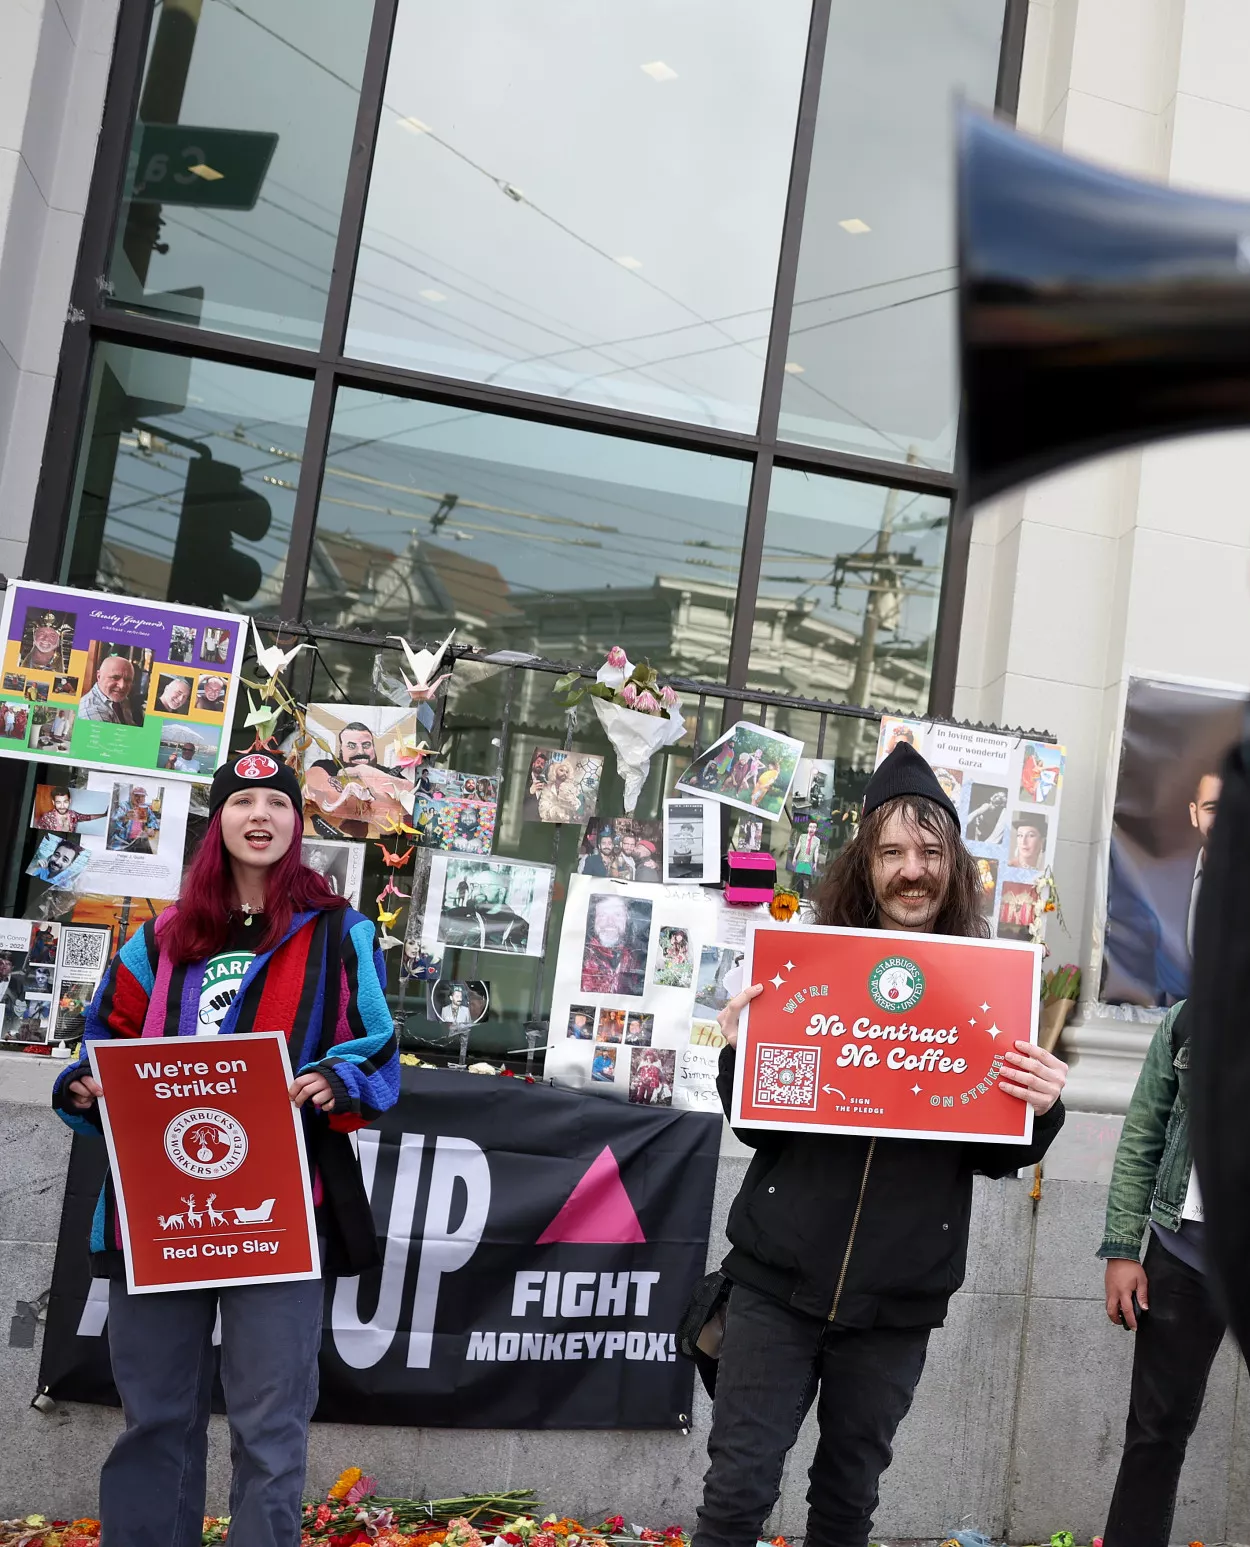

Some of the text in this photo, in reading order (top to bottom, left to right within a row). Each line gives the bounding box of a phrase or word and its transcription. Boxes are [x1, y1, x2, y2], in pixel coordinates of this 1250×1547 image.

[937, 729, 1008, 747] In loving memory
[958, 757, 982, 768] Garza
[965, 747, 1007, 759] wonderful
[664, 887, 712, 902] JAMES
[7, 934, 27, 943] Conroy
[875, 958, 920, 978] STARBUCKS
[782, 984, 829, 1014] WE'RE
[871, 980, 896, 1011] WORKERS
[901, 983, 923, 1010] UNITED
[805, 1013, 959, 1045] No Contract
[135, 1059, 248, 1079] We're on
[836, 1043, 968, 1074] No Coffee
[154, 1078, 238, 1099] Strike!
[929, 1054, 1005, 1108] ON STRIKE!
[850, 1097, 870, 1105] SIGN
[853, 1106, 884, 1114] PLEDGE
[173, 1112, 235, 1134] STARBUCKS
[171, 1139, 212, 1175] WORKERS
[220, 1135, 243, 1172] UNITED
[162, 1239, 279, 1260] Red Cup Slay
[511, 1270, 660, 1318] FIGHT
[466, 1331, 677, 1363] MONKEYPOX!
